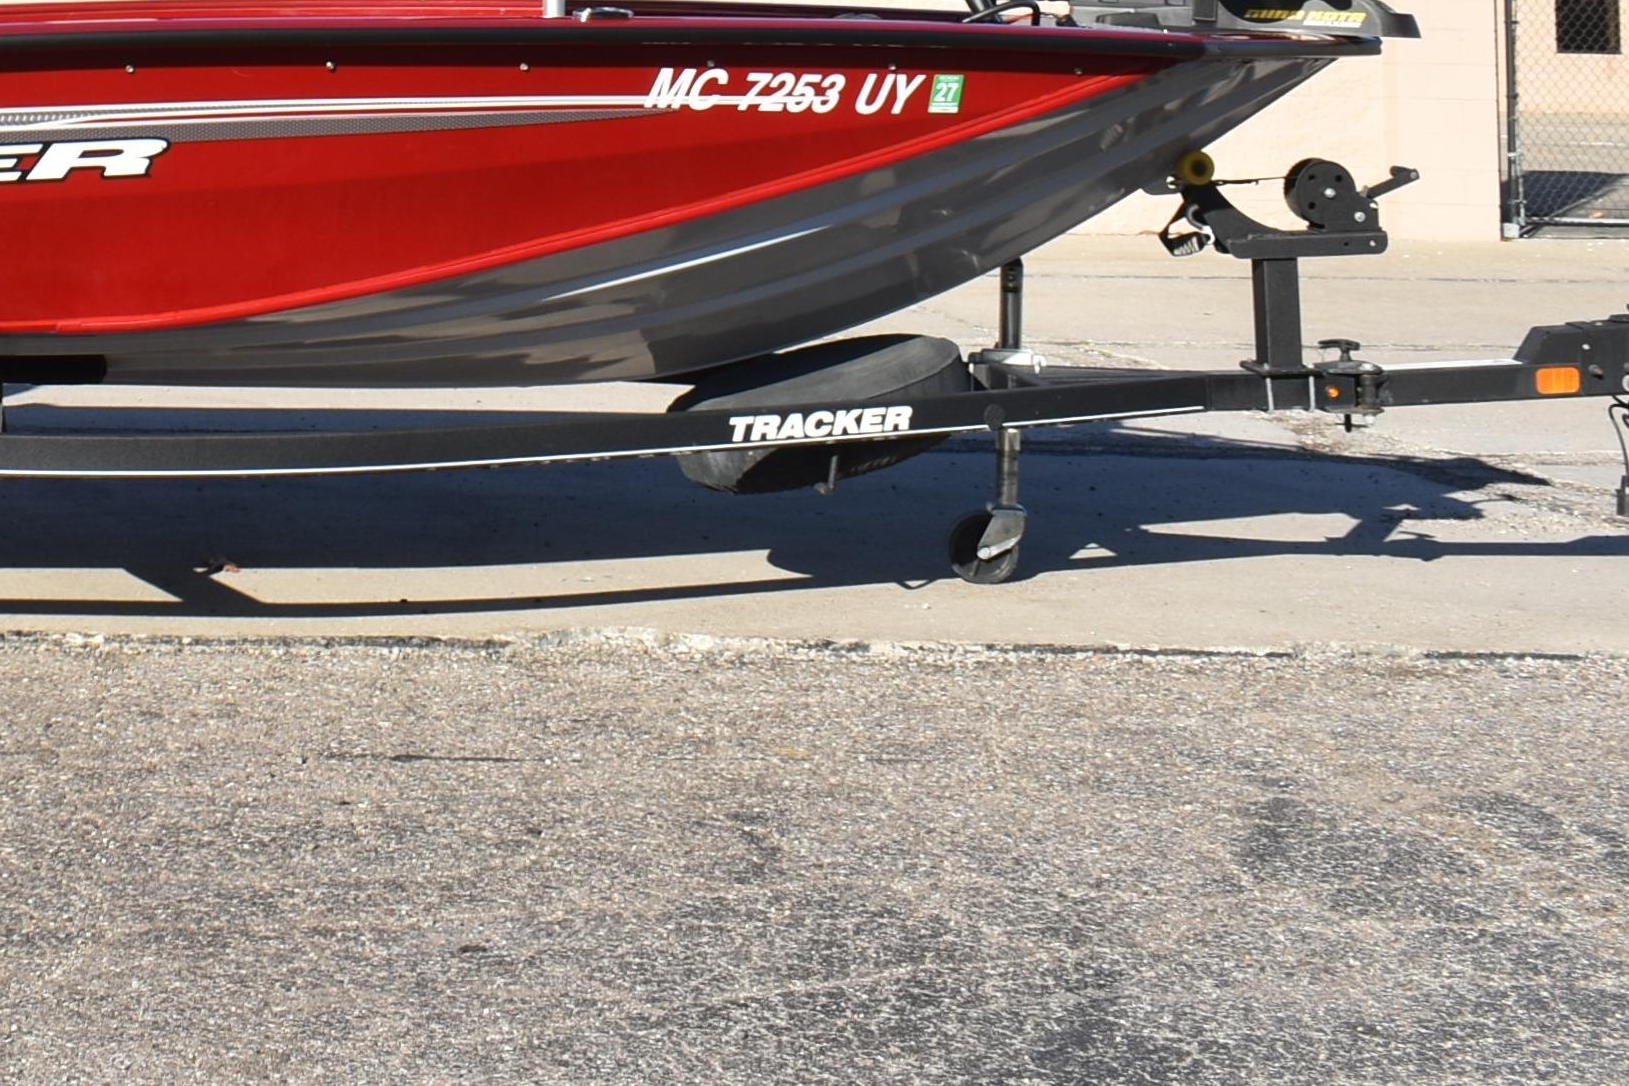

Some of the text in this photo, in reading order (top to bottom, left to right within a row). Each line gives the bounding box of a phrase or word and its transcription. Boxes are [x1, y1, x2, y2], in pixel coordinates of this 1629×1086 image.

[643, 67, 926, 114] MC 7253 UY
[933, 82, 959, 102] 27
[728, 405, 914, 443] TRACKER
